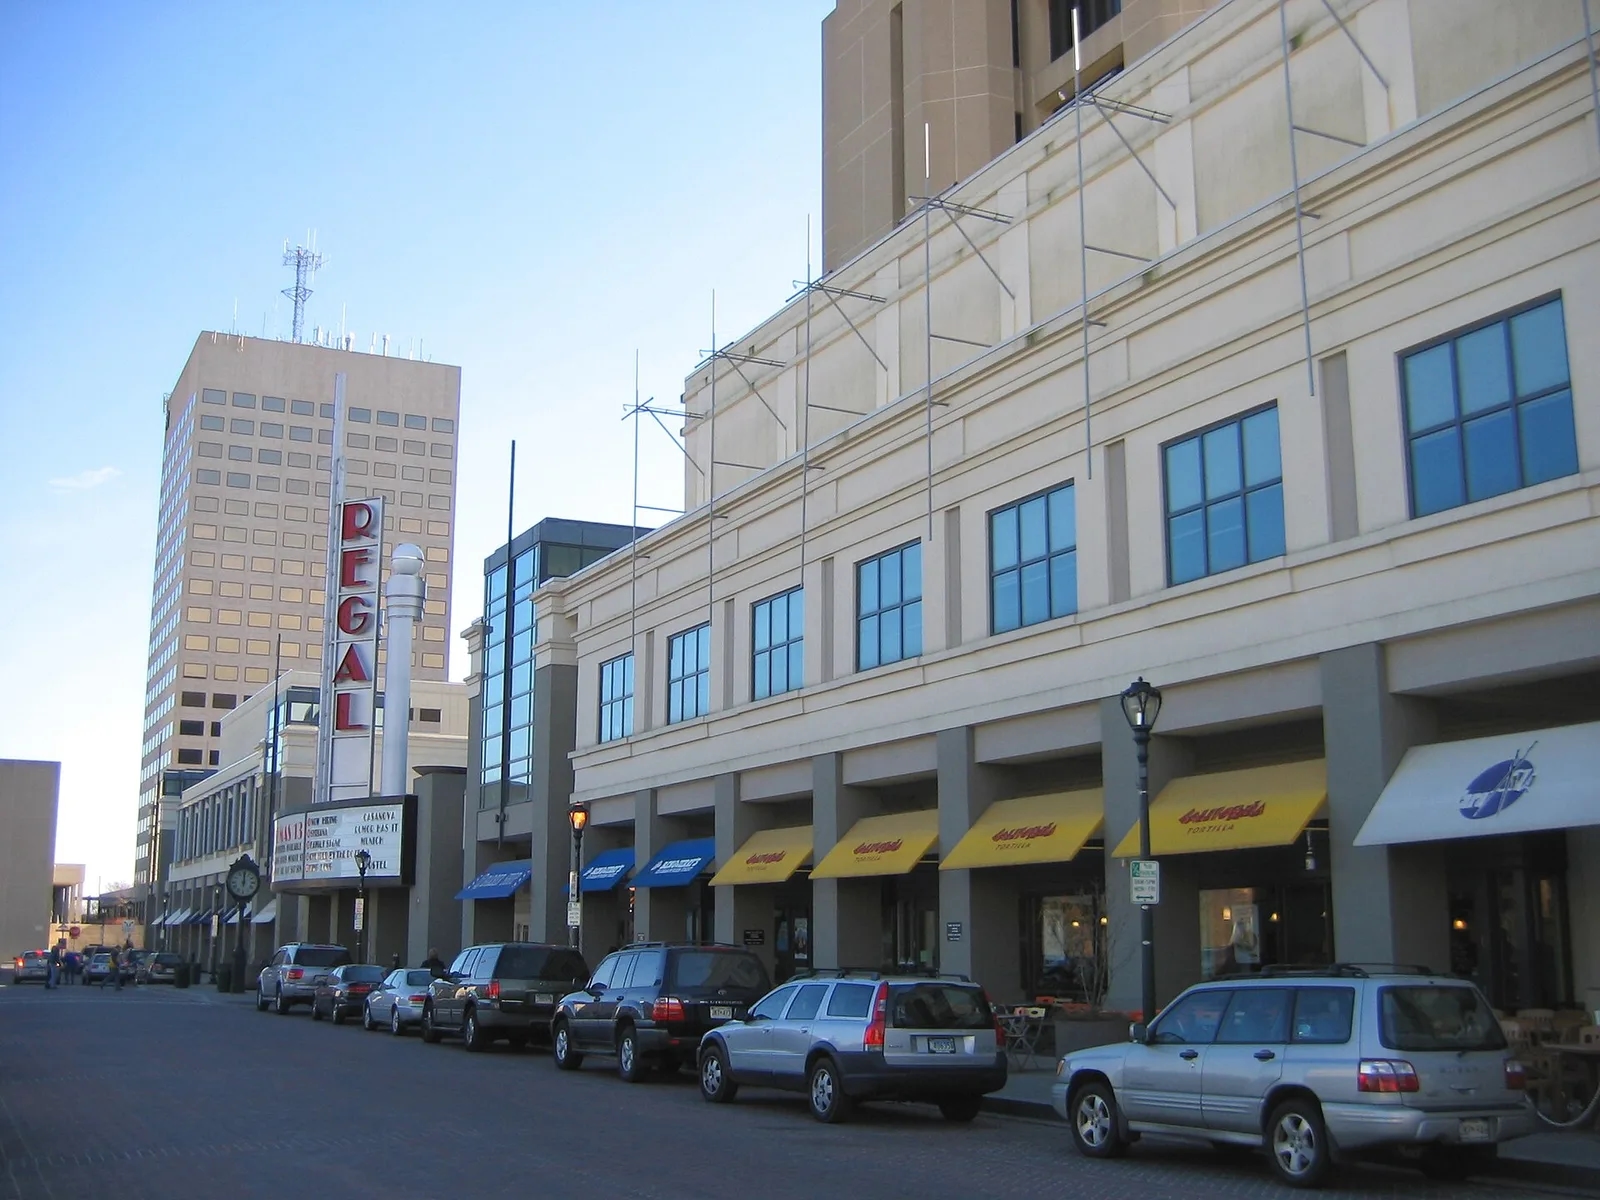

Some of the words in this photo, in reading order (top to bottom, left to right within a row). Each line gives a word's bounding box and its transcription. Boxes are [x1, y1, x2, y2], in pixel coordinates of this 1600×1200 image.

[331, 502, 377, 731] REGAL
[363, 811, 396, 821] CASANOVA
[1187, 824, 1235, 834] TORTILLA
[365, 860, 388, 870] OSTEL
